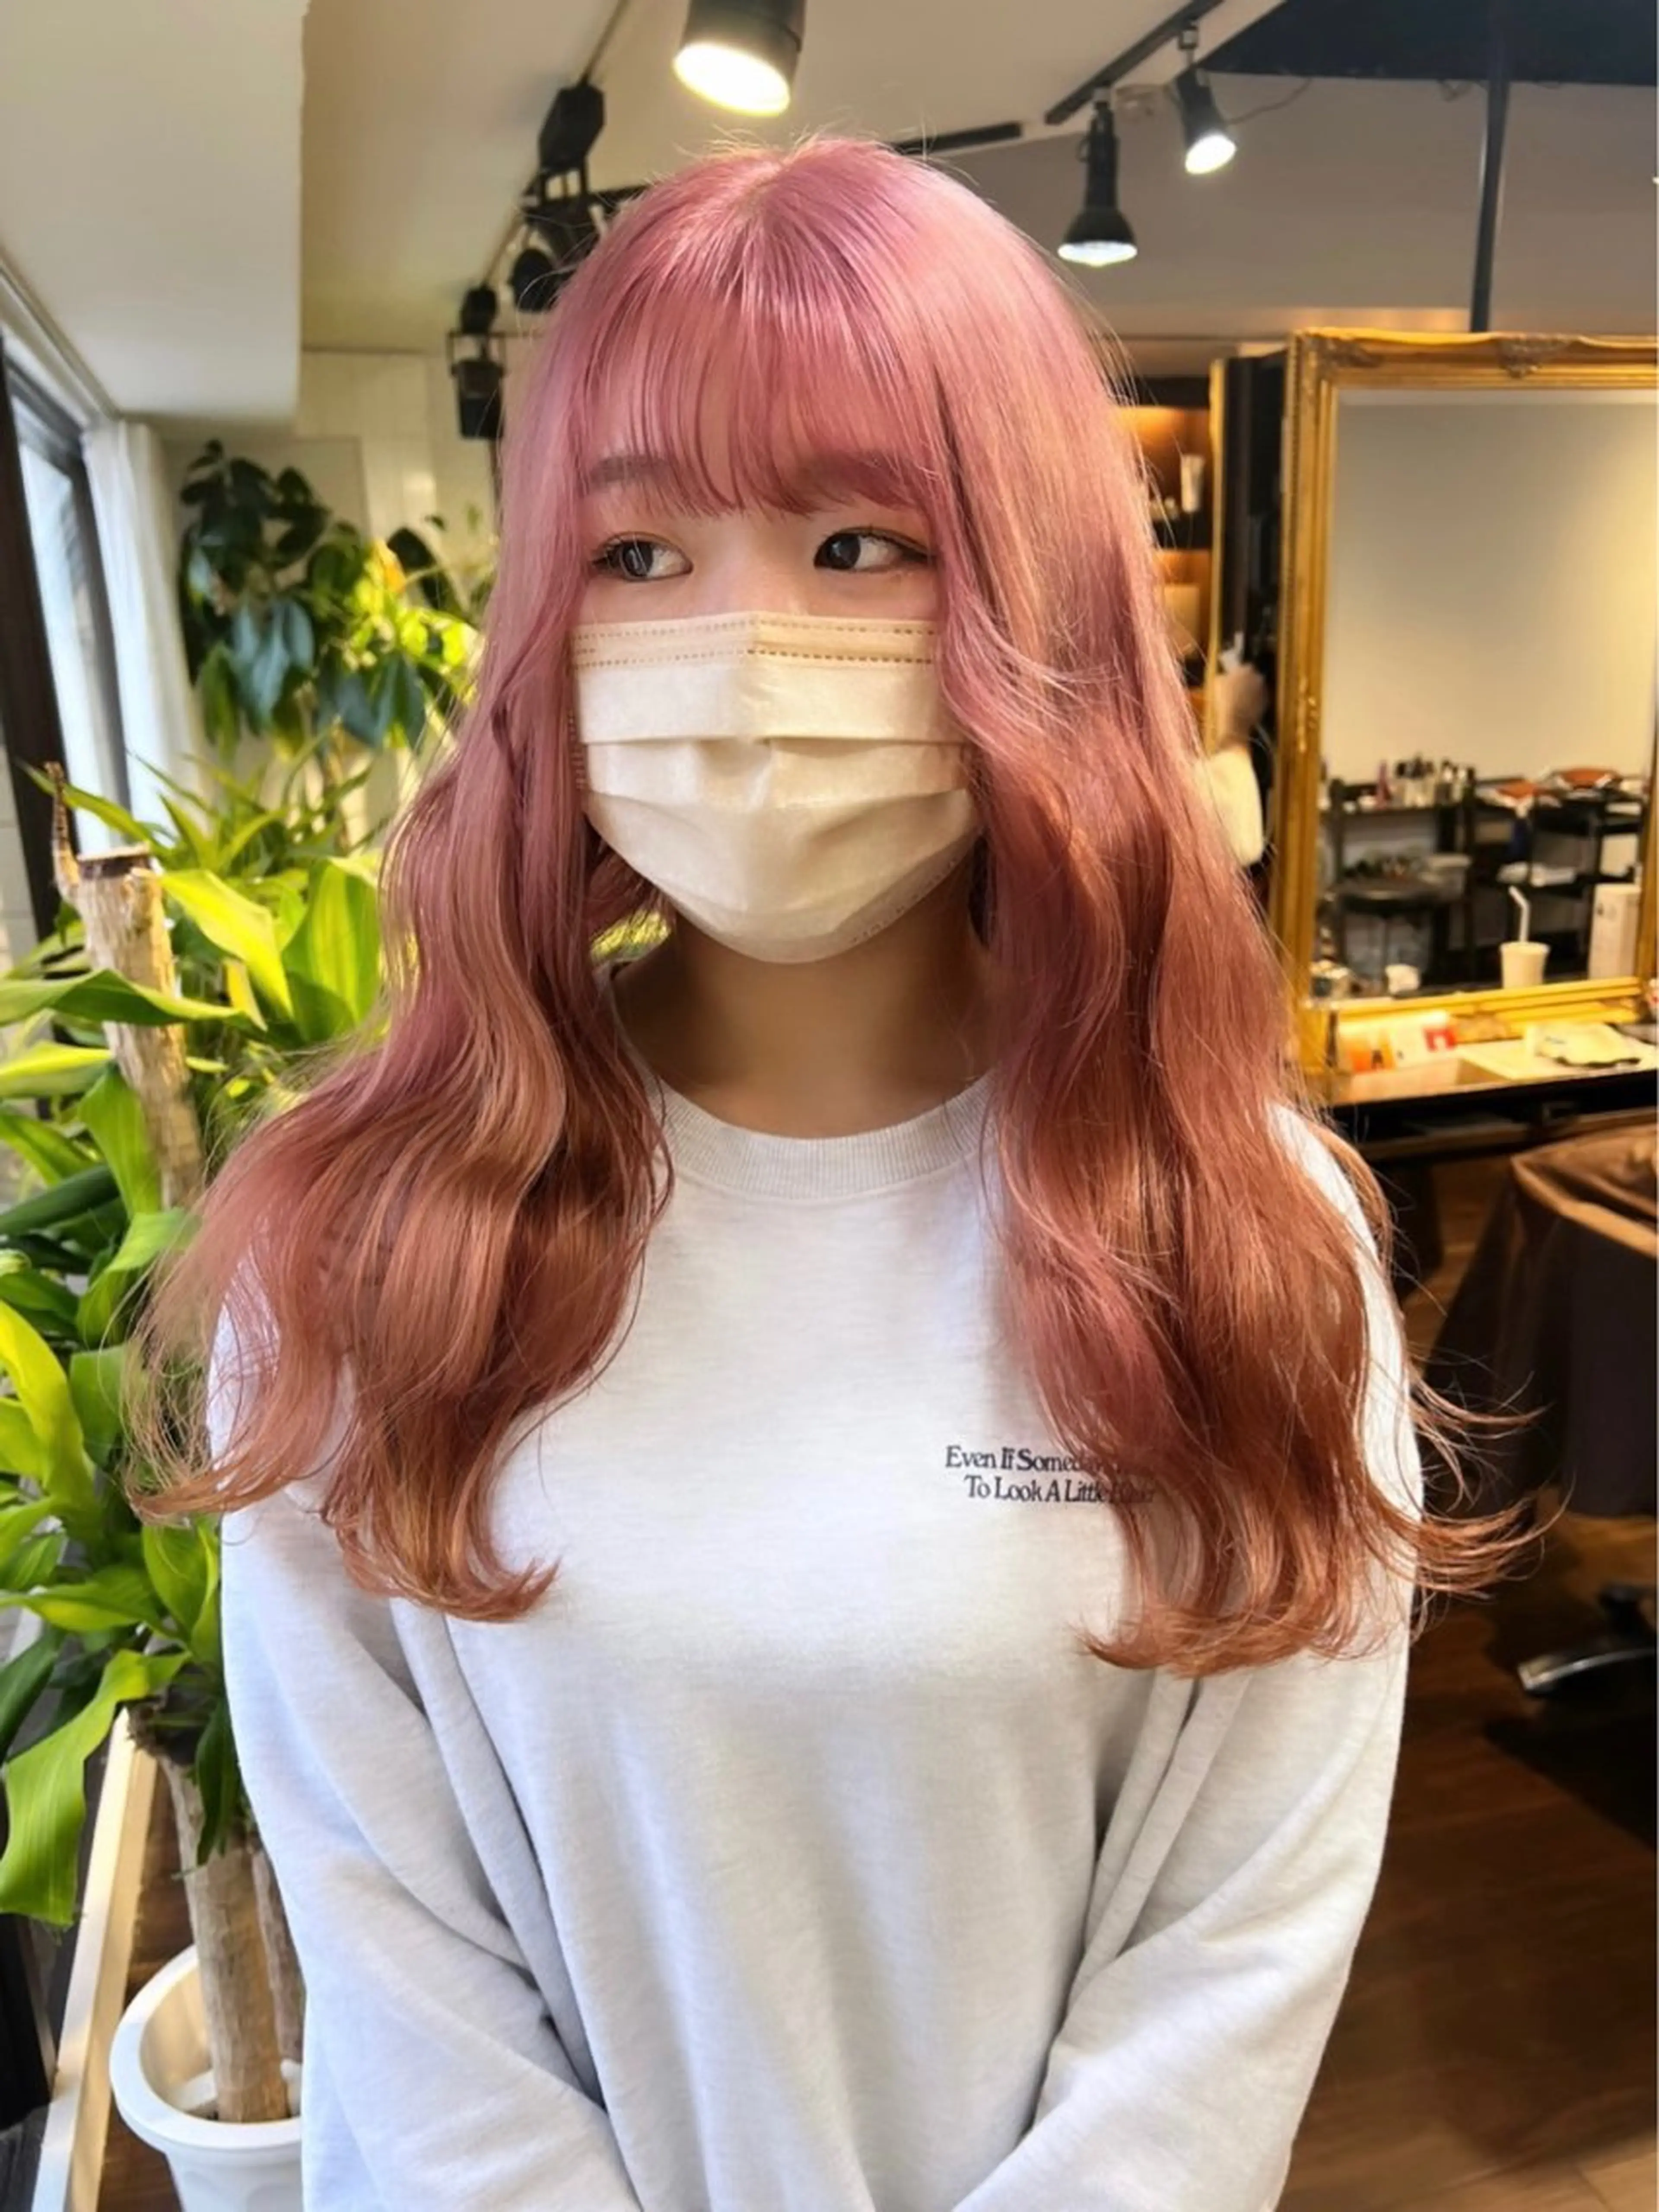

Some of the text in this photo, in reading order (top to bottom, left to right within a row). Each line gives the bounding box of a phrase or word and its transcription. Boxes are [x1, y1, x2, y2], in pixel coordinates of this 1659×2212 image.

[945, 1445, 1101, 1471] Even If Some
[964, 1474, 992, 1498] To
[995, 1476, 1042, 1501] Look
[1045, 1479, 1061, 1502] A
